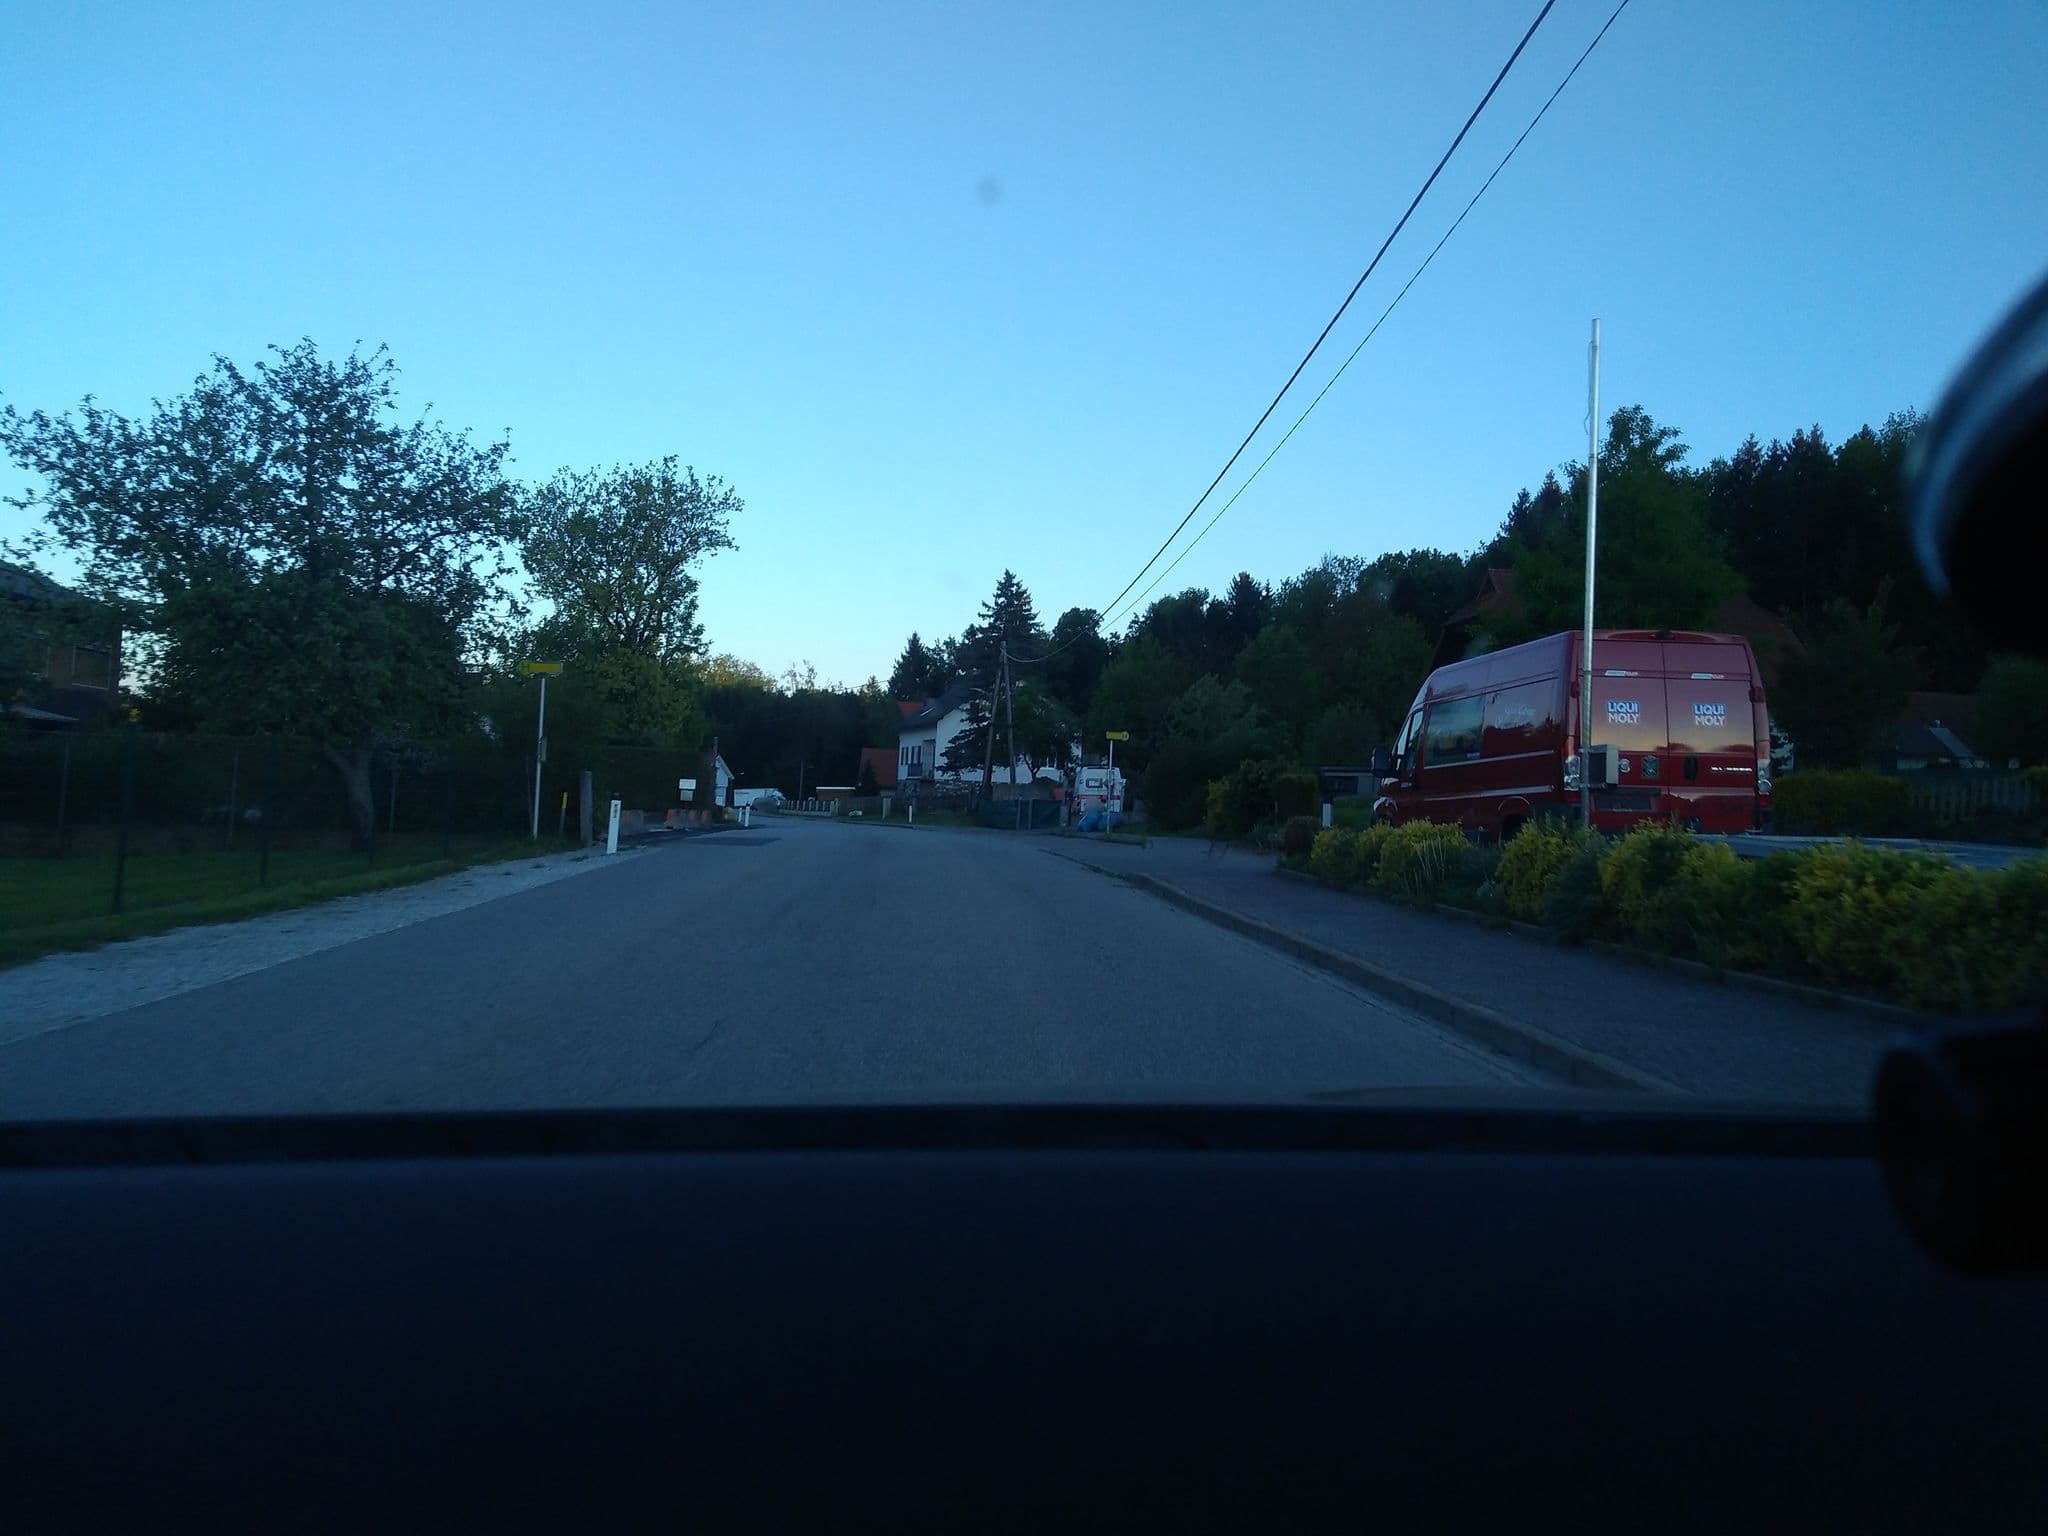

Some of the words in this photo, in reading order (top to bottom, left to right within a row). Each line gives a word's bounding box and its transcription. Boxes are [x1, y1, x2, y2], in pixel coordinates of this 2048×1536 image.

[1607, 701, 1639, 713] LIQUI
[1693, 704, 1725, 715] LIQUI
[1608, 713, 1639, 724] MOLY
[1695, 715, 1725, 726] MOLY
